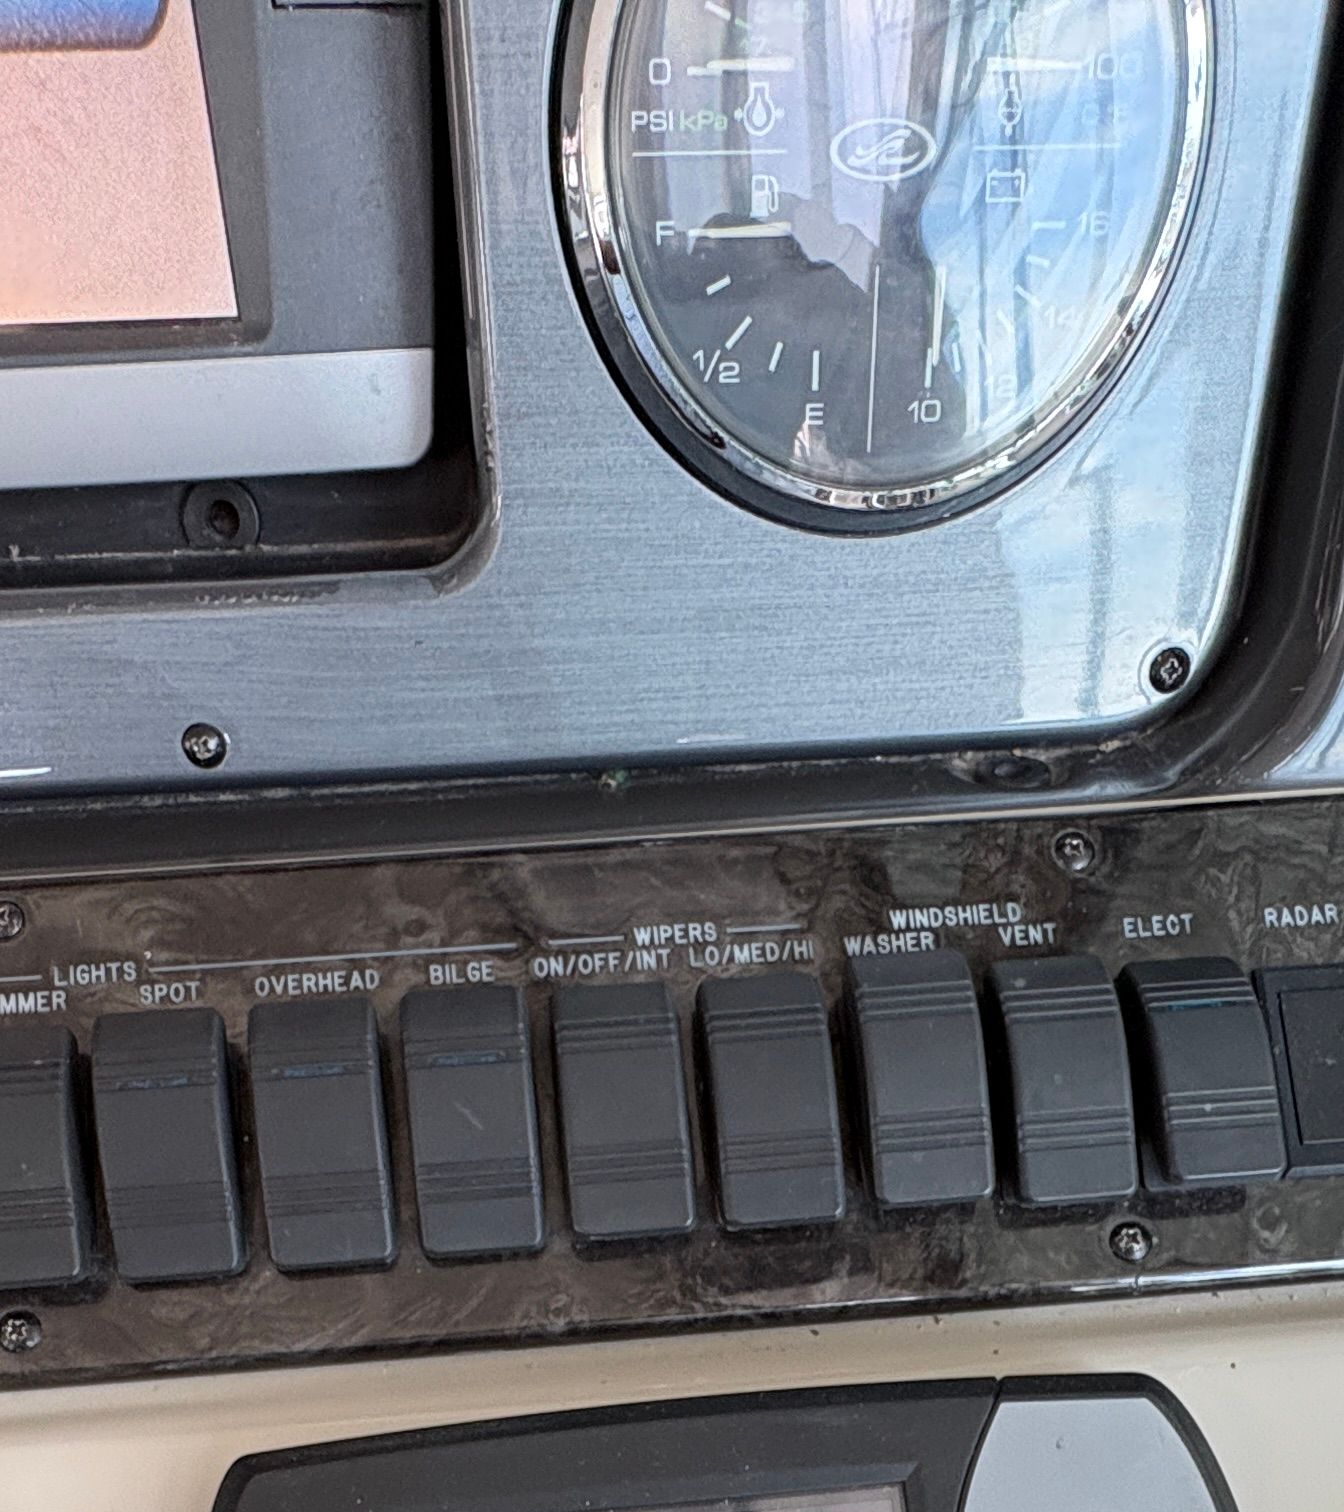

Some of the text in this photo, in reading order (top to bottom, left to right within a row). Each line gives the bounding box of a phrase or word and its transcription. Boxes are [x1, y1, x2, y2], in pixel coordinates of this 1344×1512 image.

[630, 110, 674, 132] PSI
[654, 221, 676, 246] F
[692, 350, 741, 384] 1/2
[804, 402, 824, 426] E
[907, 399, 942, 424] 10
[888, 902, 1022, 931] WINDSHIELD
[1122, 912, 1194, 939] ELECT
[1263, 903, 1339, 928] RADAR
[632, 921, 718, 947] WIPERS
[844, 922, 1057, 957] WASHER VENT
[533, 939, 814, 979] ON/OFF/INT LO/MED/HI
[53, 960, 137, 987] LIGHTS
[255, 968, 380, 998] OVERHEAD
[429, 960, 495, 986] BILGE
[139, 980, 200, 1005] SPOT
